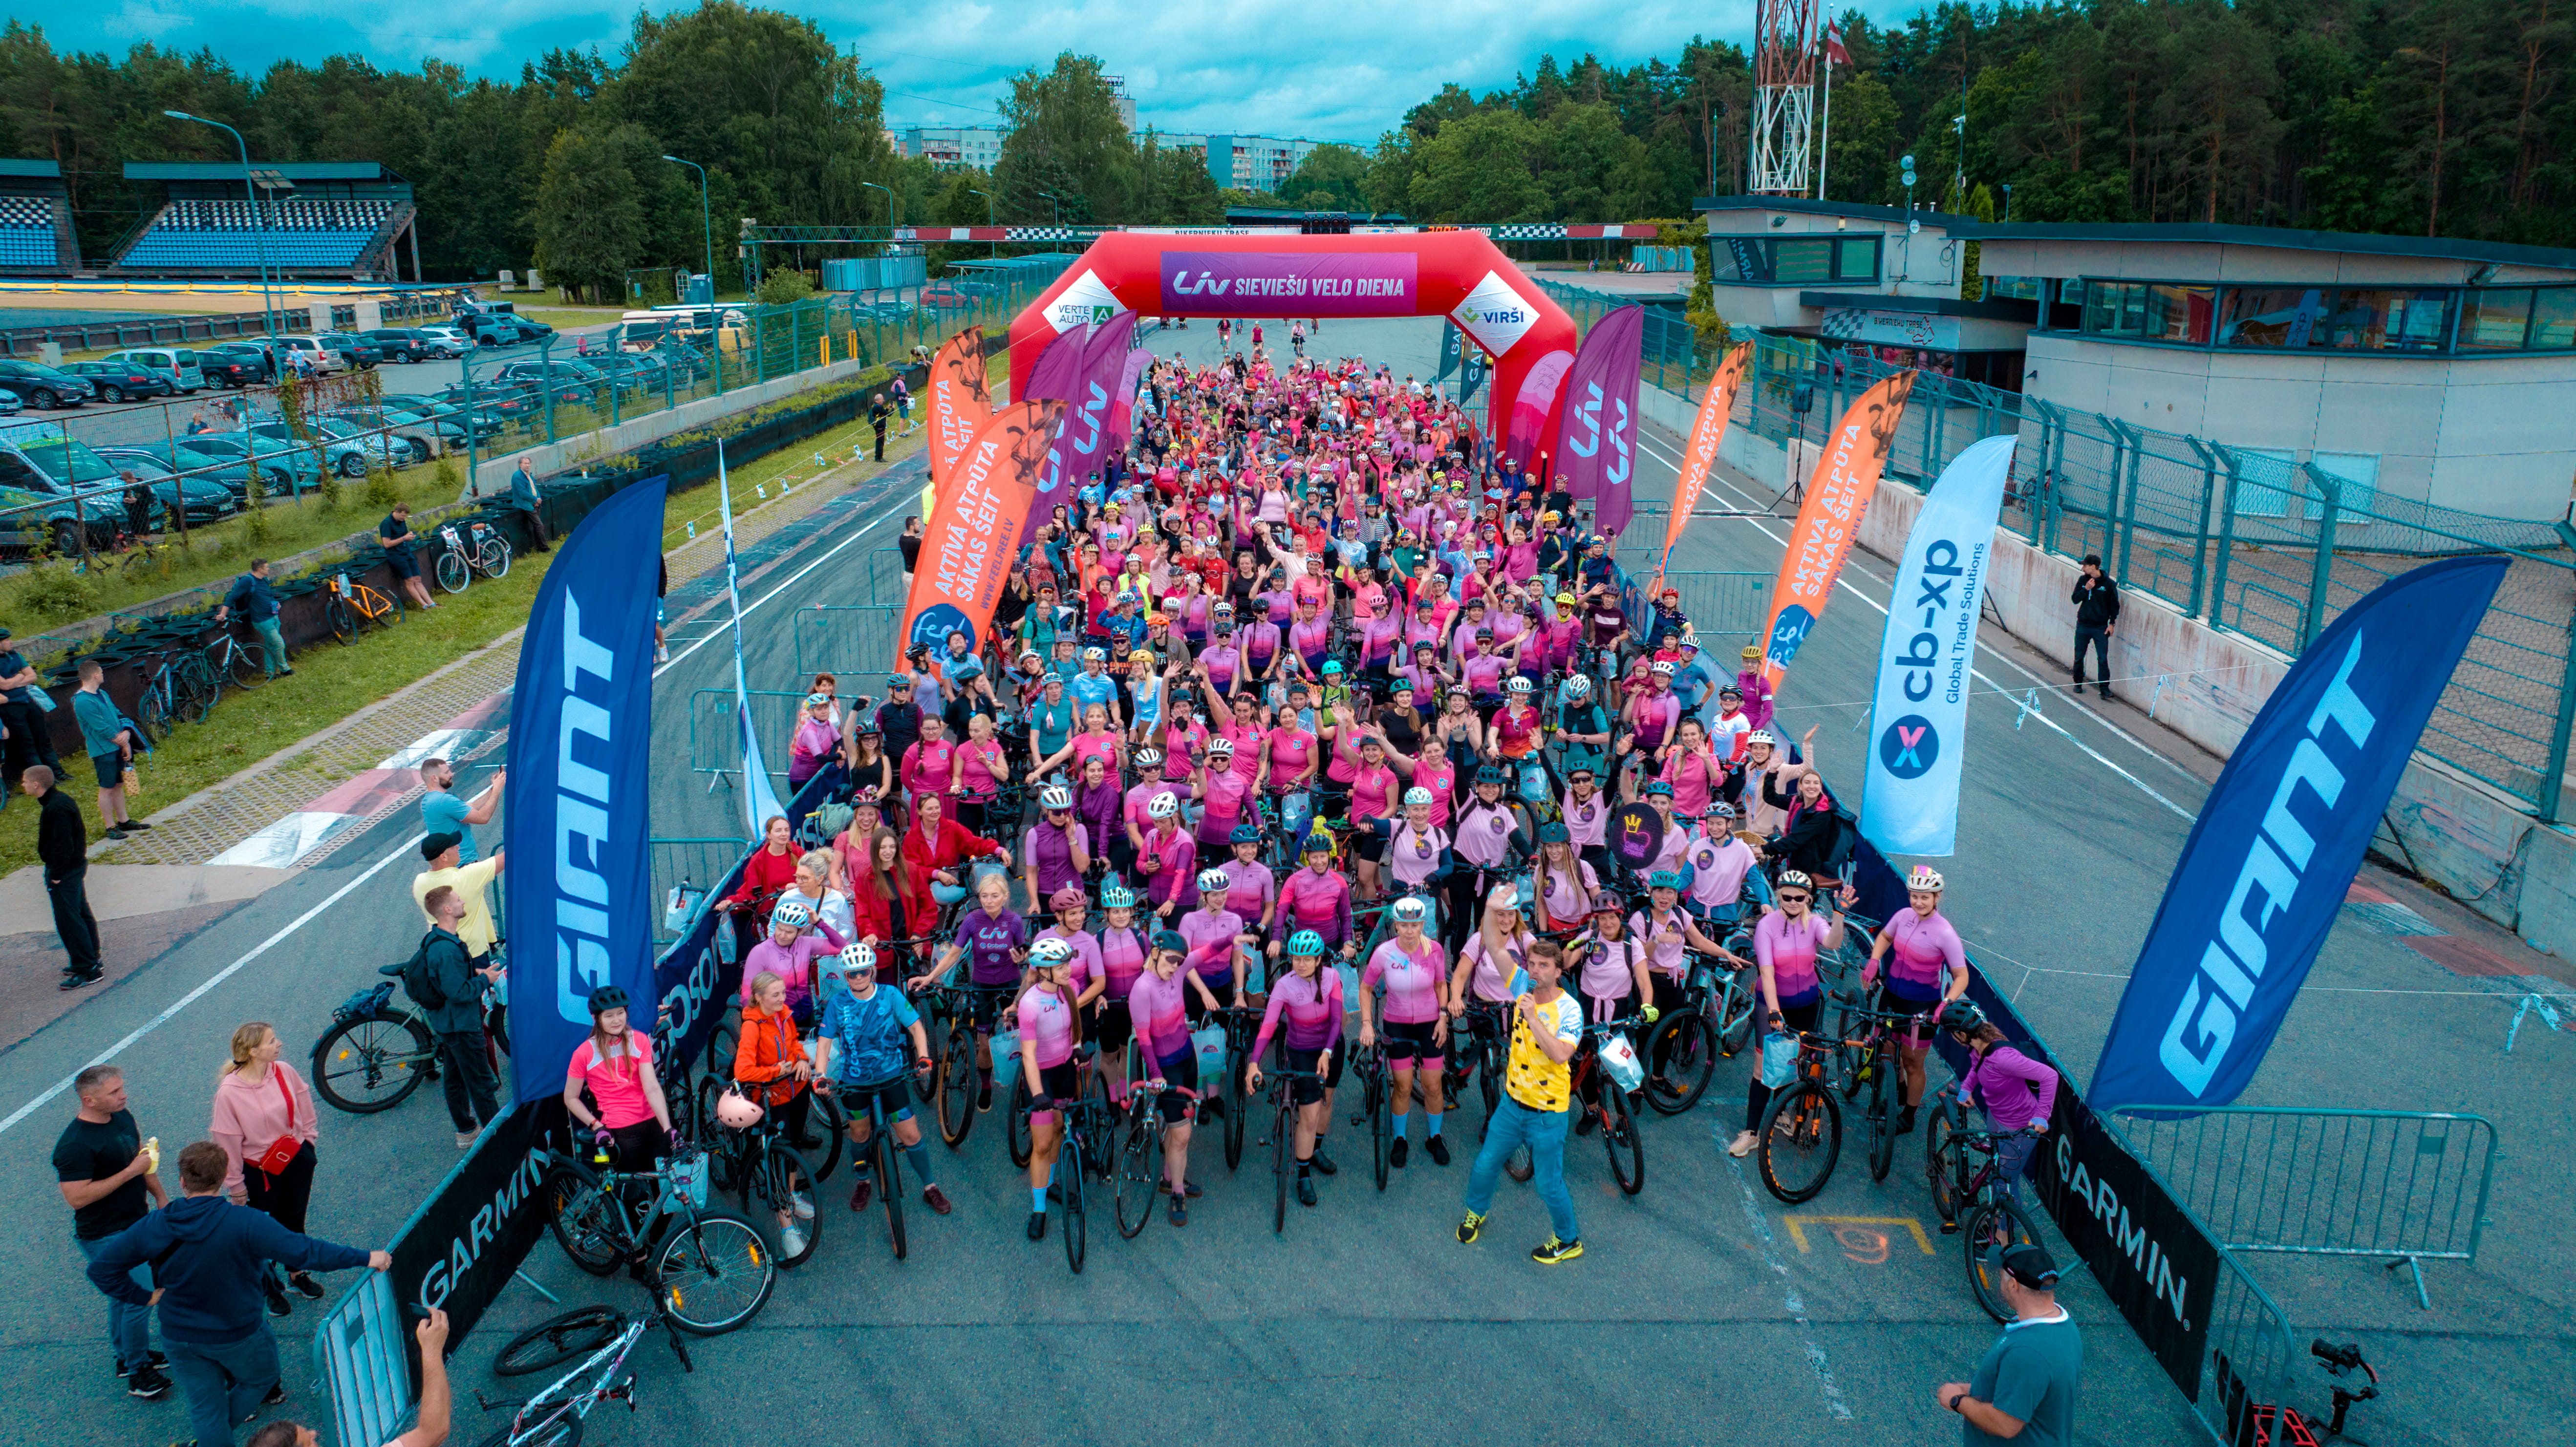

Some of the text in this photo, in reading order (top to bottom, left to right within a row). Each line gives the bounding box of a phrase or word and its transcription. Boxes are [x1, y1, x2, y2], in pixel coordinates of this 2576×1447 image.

[1058, 305, 1090, 314] VERTE
[1059, 315, 1089, 324] AUTO
[1173, 271, 1404, 296] Liv SIEVIEŠU VELO DIENA
[1483, 307, 1524, 323] VIRŠI
[1906, 320, 1923, 329] TRASE
[937, 380, 960, 451] ATPŪTA
[957, 416, 974, 452] EIT
[1075, 380, 1108, 454] Liv
[1569, 380, 1603, 457] Liv
[1607, 397, 1629, 485] Liv
[1697, 386, 1722, 458] ATPŪTA
[1703, 423, 1719, 463] ŠEIT
[936, 441, 999, 596] AKTĪVĀ ATPŪTA
[957, 487, 1001, 601] SĀKAS ŠEIT
[1791, 425, 1861, 596] AKTĪVĀ ATPŪTA
[1806, 471, 1861, 597] SĀKAS ŠEIT
[980, 518, 1015, 610] WWW.FEELFREE.LV
[1895, 539, 1963, 702] cb-xp
[1946, 543, 1984, 704] Global Trade Solutions
[557, 584, 614, 1025] GIANT
[1625, 841, 1645, 852] GIRLS
[2160, 627, 2376, 1098] GIANT
[979, 927, 1008, 939] Liv
[2058, 1134, 2187, 1322] GARMIN
